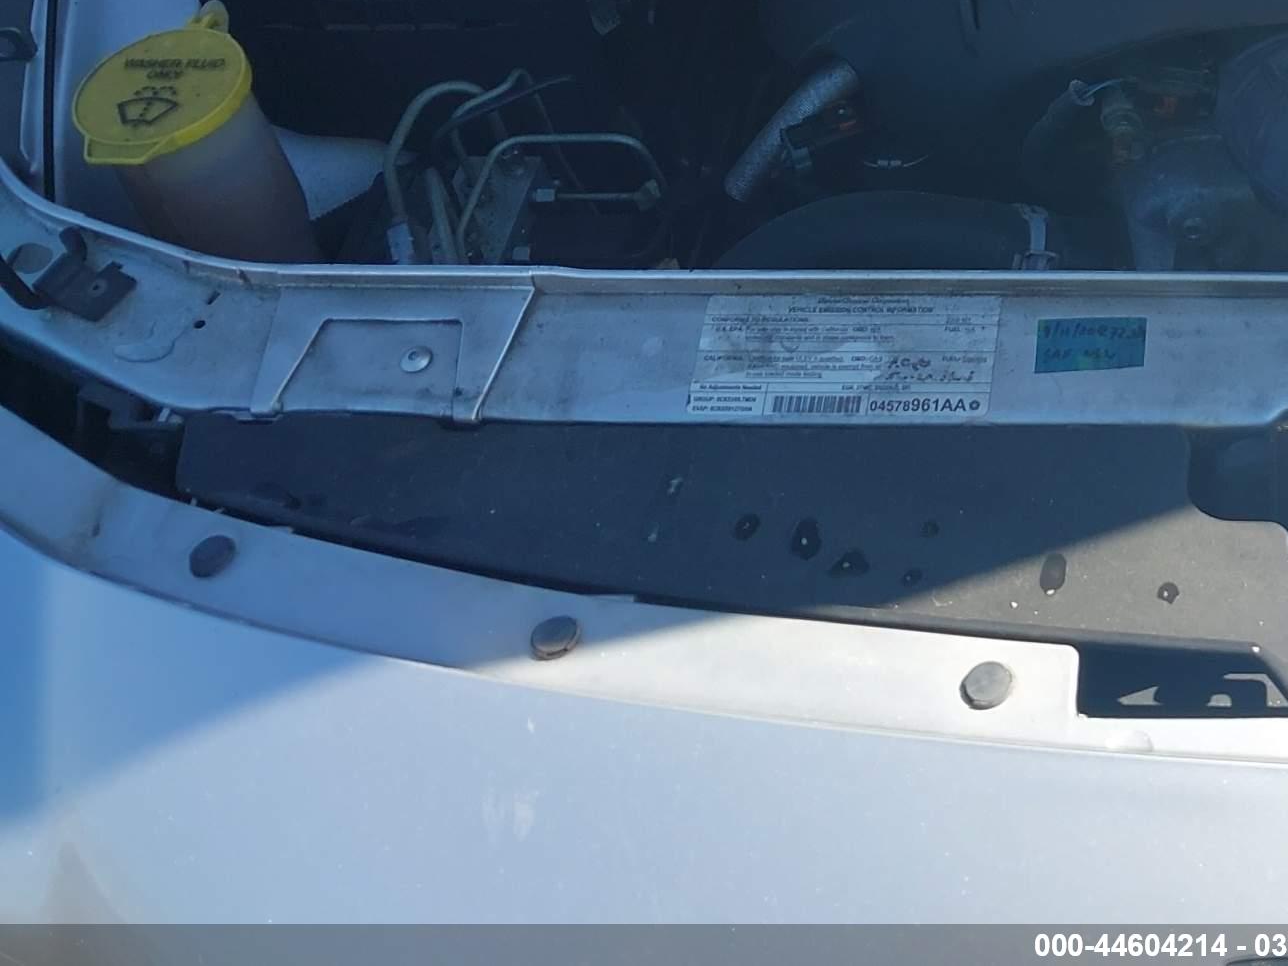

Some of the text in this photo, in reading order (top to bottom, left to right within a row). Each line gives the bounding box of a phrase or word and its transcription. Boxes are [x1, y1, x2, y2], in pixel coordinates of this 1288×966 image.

[124, 57, 226, 69] WASHER FLUID
[146, 70, 184, 79] ONLY
[869, 398, 966, 412] 04578961AA
